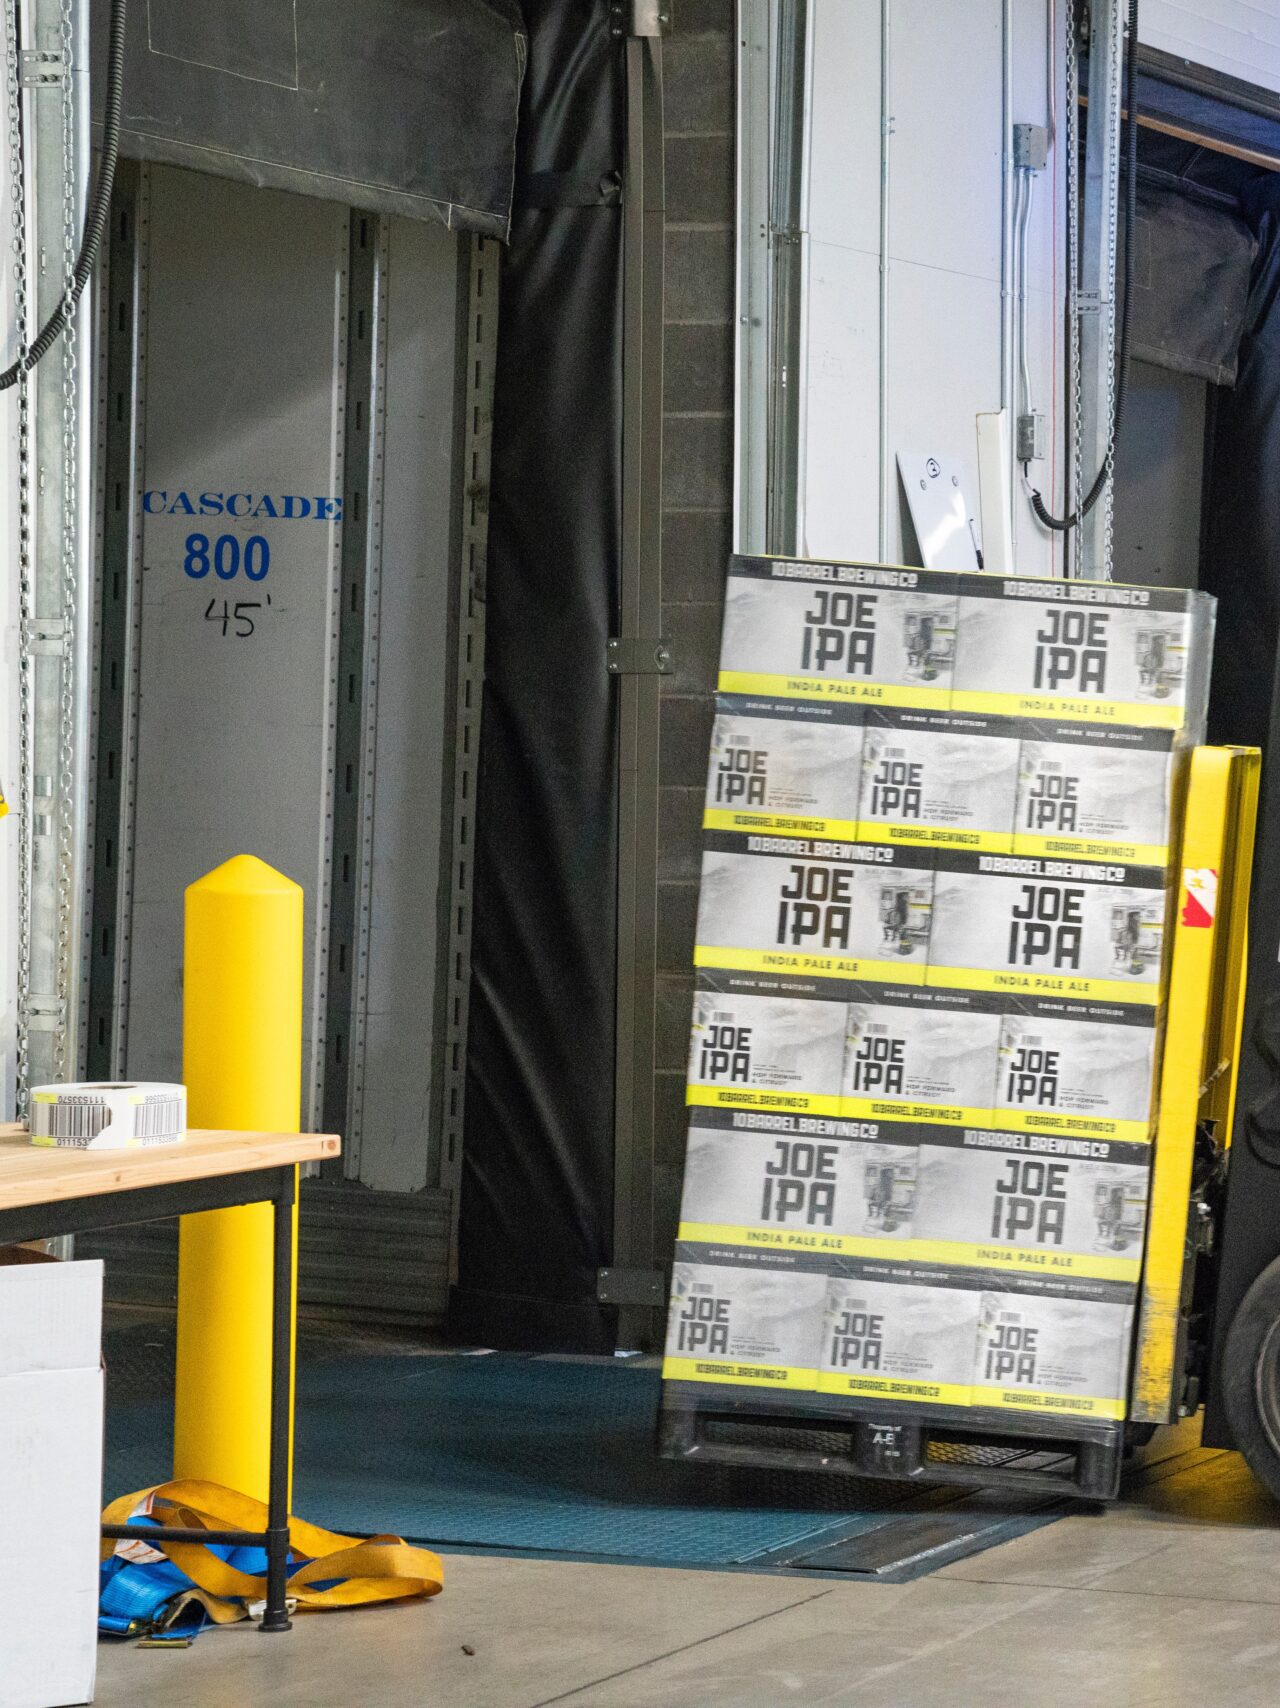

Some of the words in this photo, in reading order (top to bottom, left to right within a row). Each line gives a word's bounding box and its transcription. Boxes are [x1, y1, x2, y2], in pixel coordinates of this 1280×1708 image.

[143, 490, 343, 520] CASCADE
[184, 533, 270, 581] 800
[805, 590, 878, 628] JOE
[1037, 609, 1110, 647] JOE
[800, 626, 876, 675] IPA
[1032, 645, 1108, 694] IPA
[788, 680, 823, 691] INDIA
[828, 683, 857, 695] PALE
[862, 686, 883, 697] ALE
[1020, 699, 1055, 710] INDIA
[1060, 702, 1089, 714] PALE
[1094, 705, 1116, 716] ALE
[718, 748, 768, 773] JOE
[873, 761, 923, 786] JOE
[716, 773, 766, 805] IPA
[871, 786, 921, 818] IPA
[1029, 774, 1079, 799] JOE
[1027, 799, 1077, 831] IPA
[781, 865, 854, 903] JOE
[1012, 885, 1085, 923] JOE
[776, 901, 852, 950] IPA
[1007, 921, 1083, 970] IPA
[763, 955, 798, 966] INDIA
[803, 958, 832, 970] PALE
[837, 961, 859, 972] ALE
[994, 975, 1029, 986] INDIA
[1034, 978, 1063, 990] PALE
[1068, 981, 1090, 992] ALE
[702, 1025, 752, 1050] JOE
[856, 1037, 906, 1062] JOE
[700, 1050, 750, 1082] IPA
[1010, 1049, 1060, 1074] JOE
[854, 1062, 903, 1094] IPA
[1007, 1074, 1057, 1106] IPA
[766, 1141, 839, 1179] JOE
[996, 1160, 1069, 1198] JOE
[761, 1177, 836, 1226] IPA
[991, 1196, 1066, 1245] IPA
[748, 1231, 782, 1242] INDIA
[787, 1234, 816, 1246] PALE
[821, 1237, 843, 1248] ALE
[977, 1250, 1012, 1261] INDIA
[1017, 1253, 1046, 1265] PALE
[1051, 1256, 1073, 1267] ALE
[681, 1297, 731, 1322] JOE
[834, 1312, 884, 1337] JOE
[678, 1322, 728, 1354] IPA
[831, 1337, 881, 1369] IPA
[988, 1326, 1038, 1351] JOE
[986, 1351, 1035, 1383] IPA
